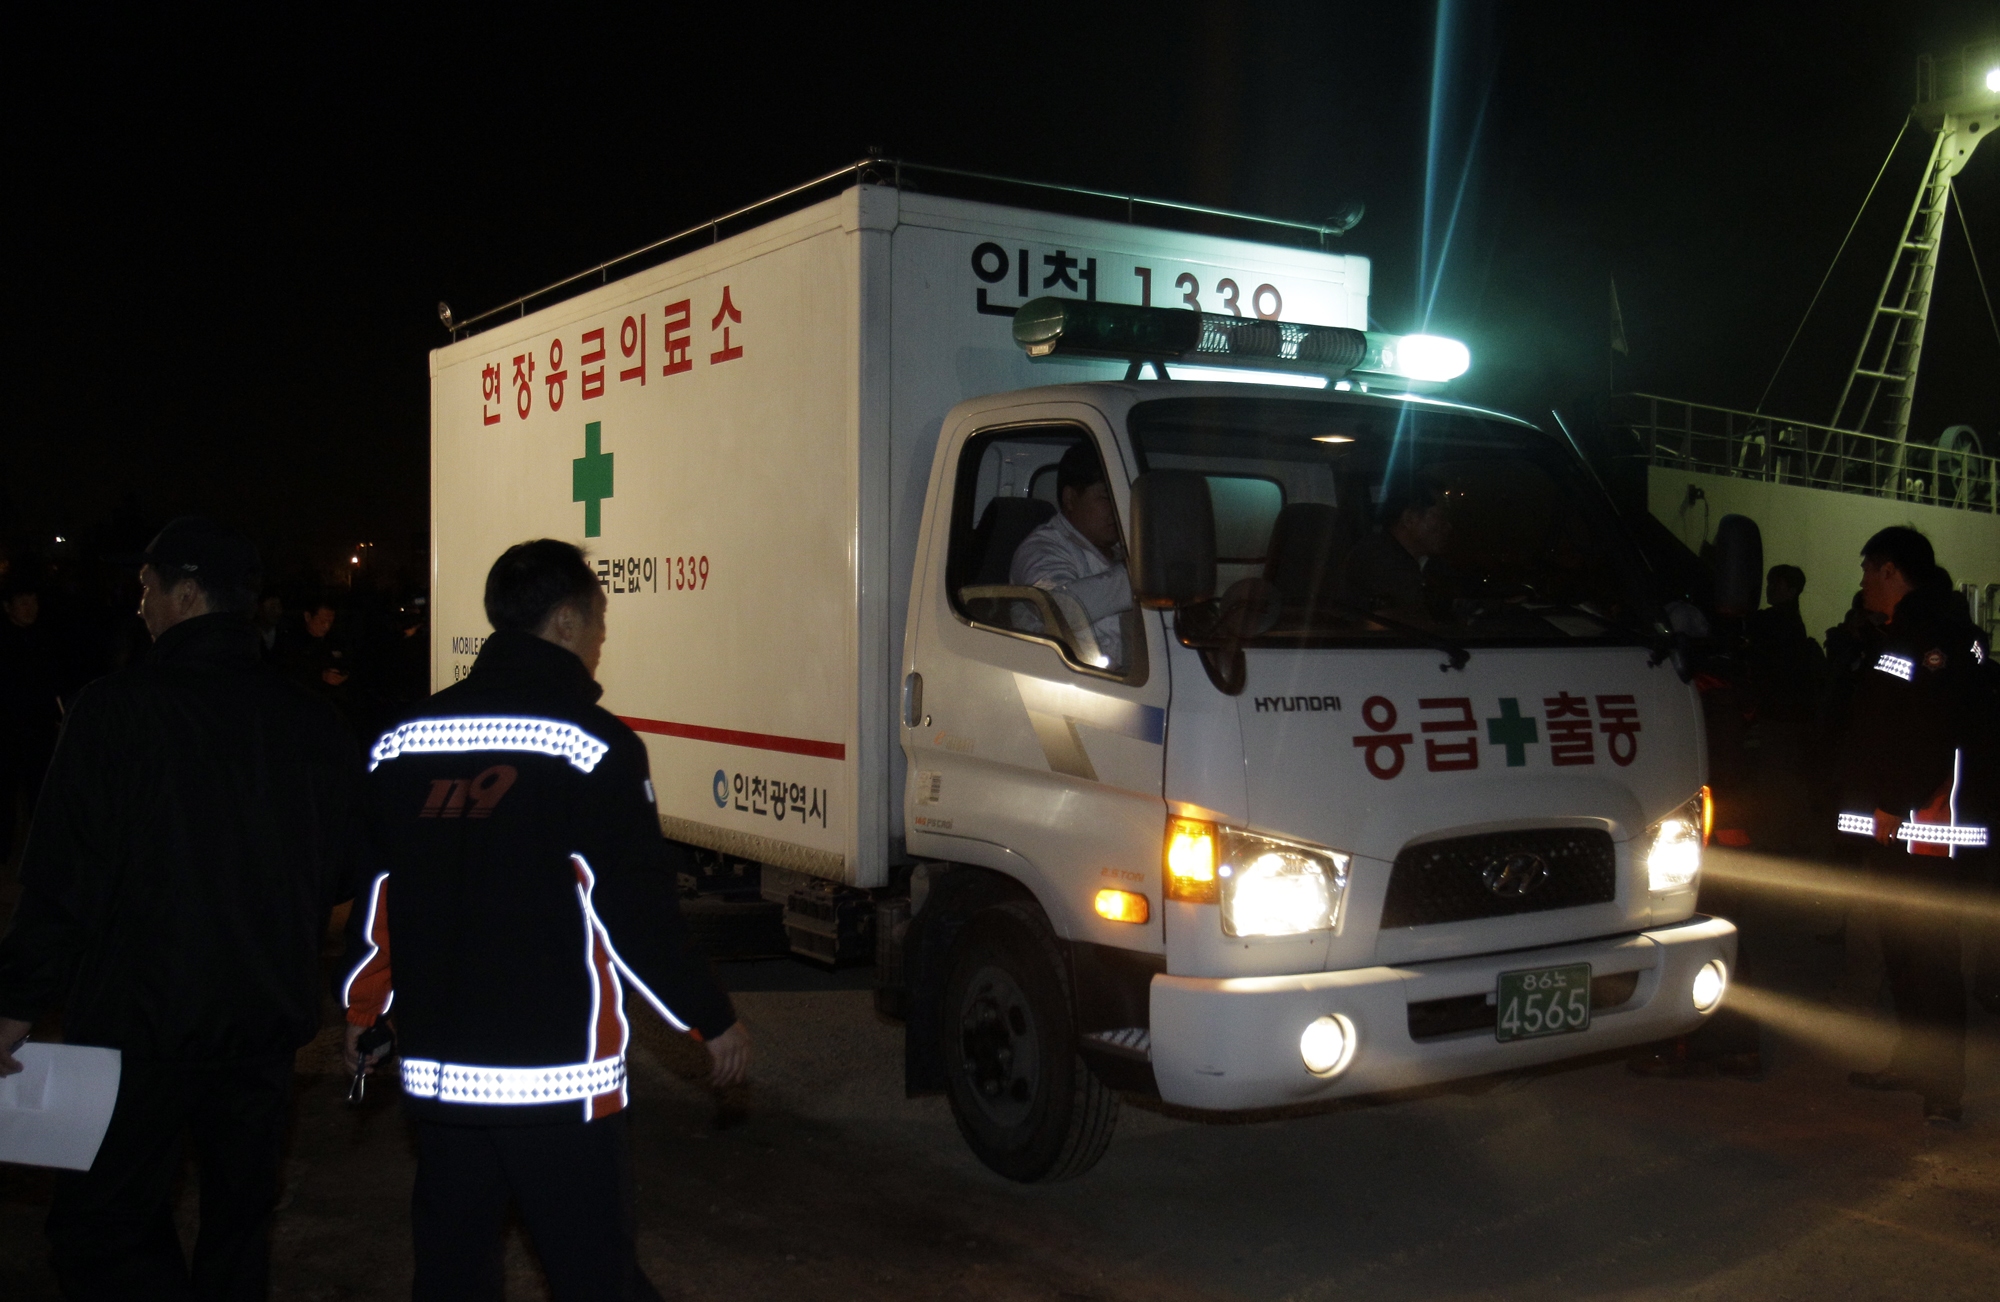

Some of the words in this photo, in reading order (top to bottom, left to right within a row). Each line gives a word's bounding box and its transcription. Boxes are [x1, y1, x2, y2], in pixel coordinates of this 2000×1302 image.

[666, 556, 709, 590] 1339
[452, 636, 479, 655] MOBILE
[1255, 696, 1341, 712] HYUNDAI
[1352, 695, 1480, 781] 응급
[1543, 691, 1642, 767] 출동
[418, 764, 519, 819] 119
[733, 772, 827, 829] 인천광역시
[1523, 971, 1567, 991] 86노
[1501, 988, 1585, 1035] 4565
